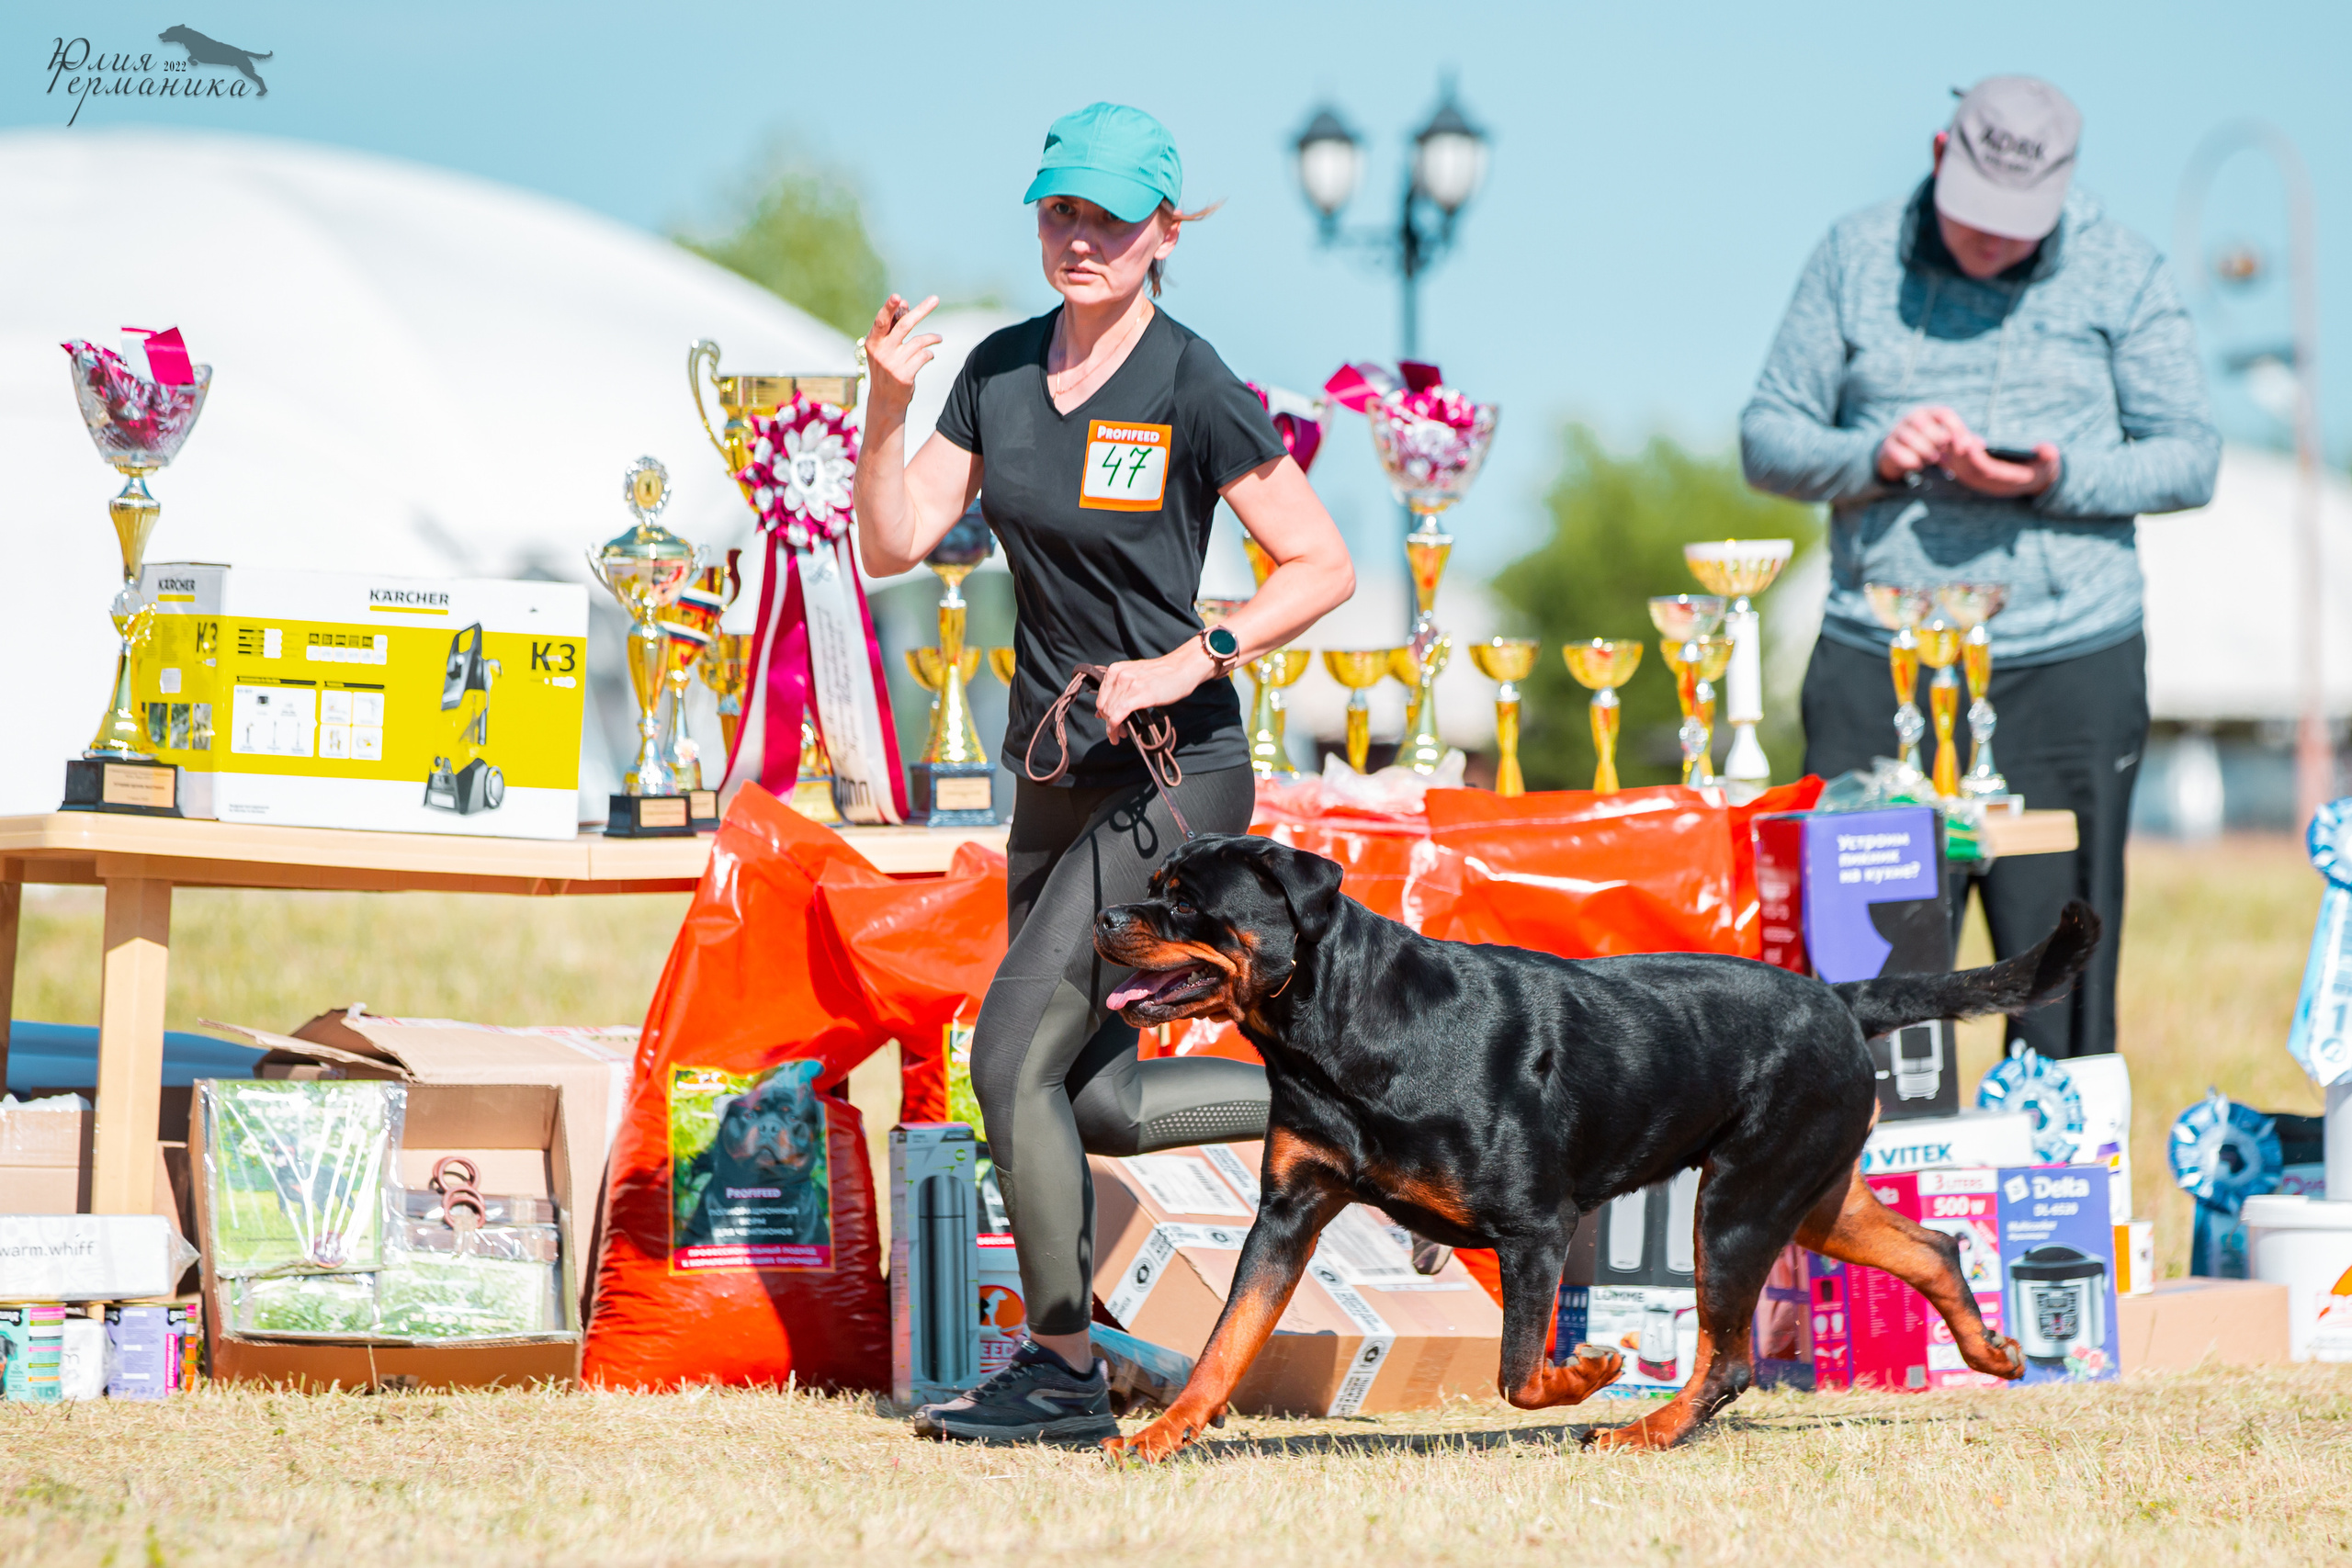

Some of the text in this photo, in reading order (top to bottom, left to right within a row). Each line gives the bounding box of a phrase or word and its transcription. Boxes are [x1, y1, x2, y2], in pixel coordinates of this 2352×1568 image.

[1102, 445, 1152, 489] 47
[1839, 868, 1862, 885] на
[1879, 1143, 1953, 1167] VITEK
[2031, 1175, 2089, 1199] Delta
[1933, 1196, 1970, 1217] 500
